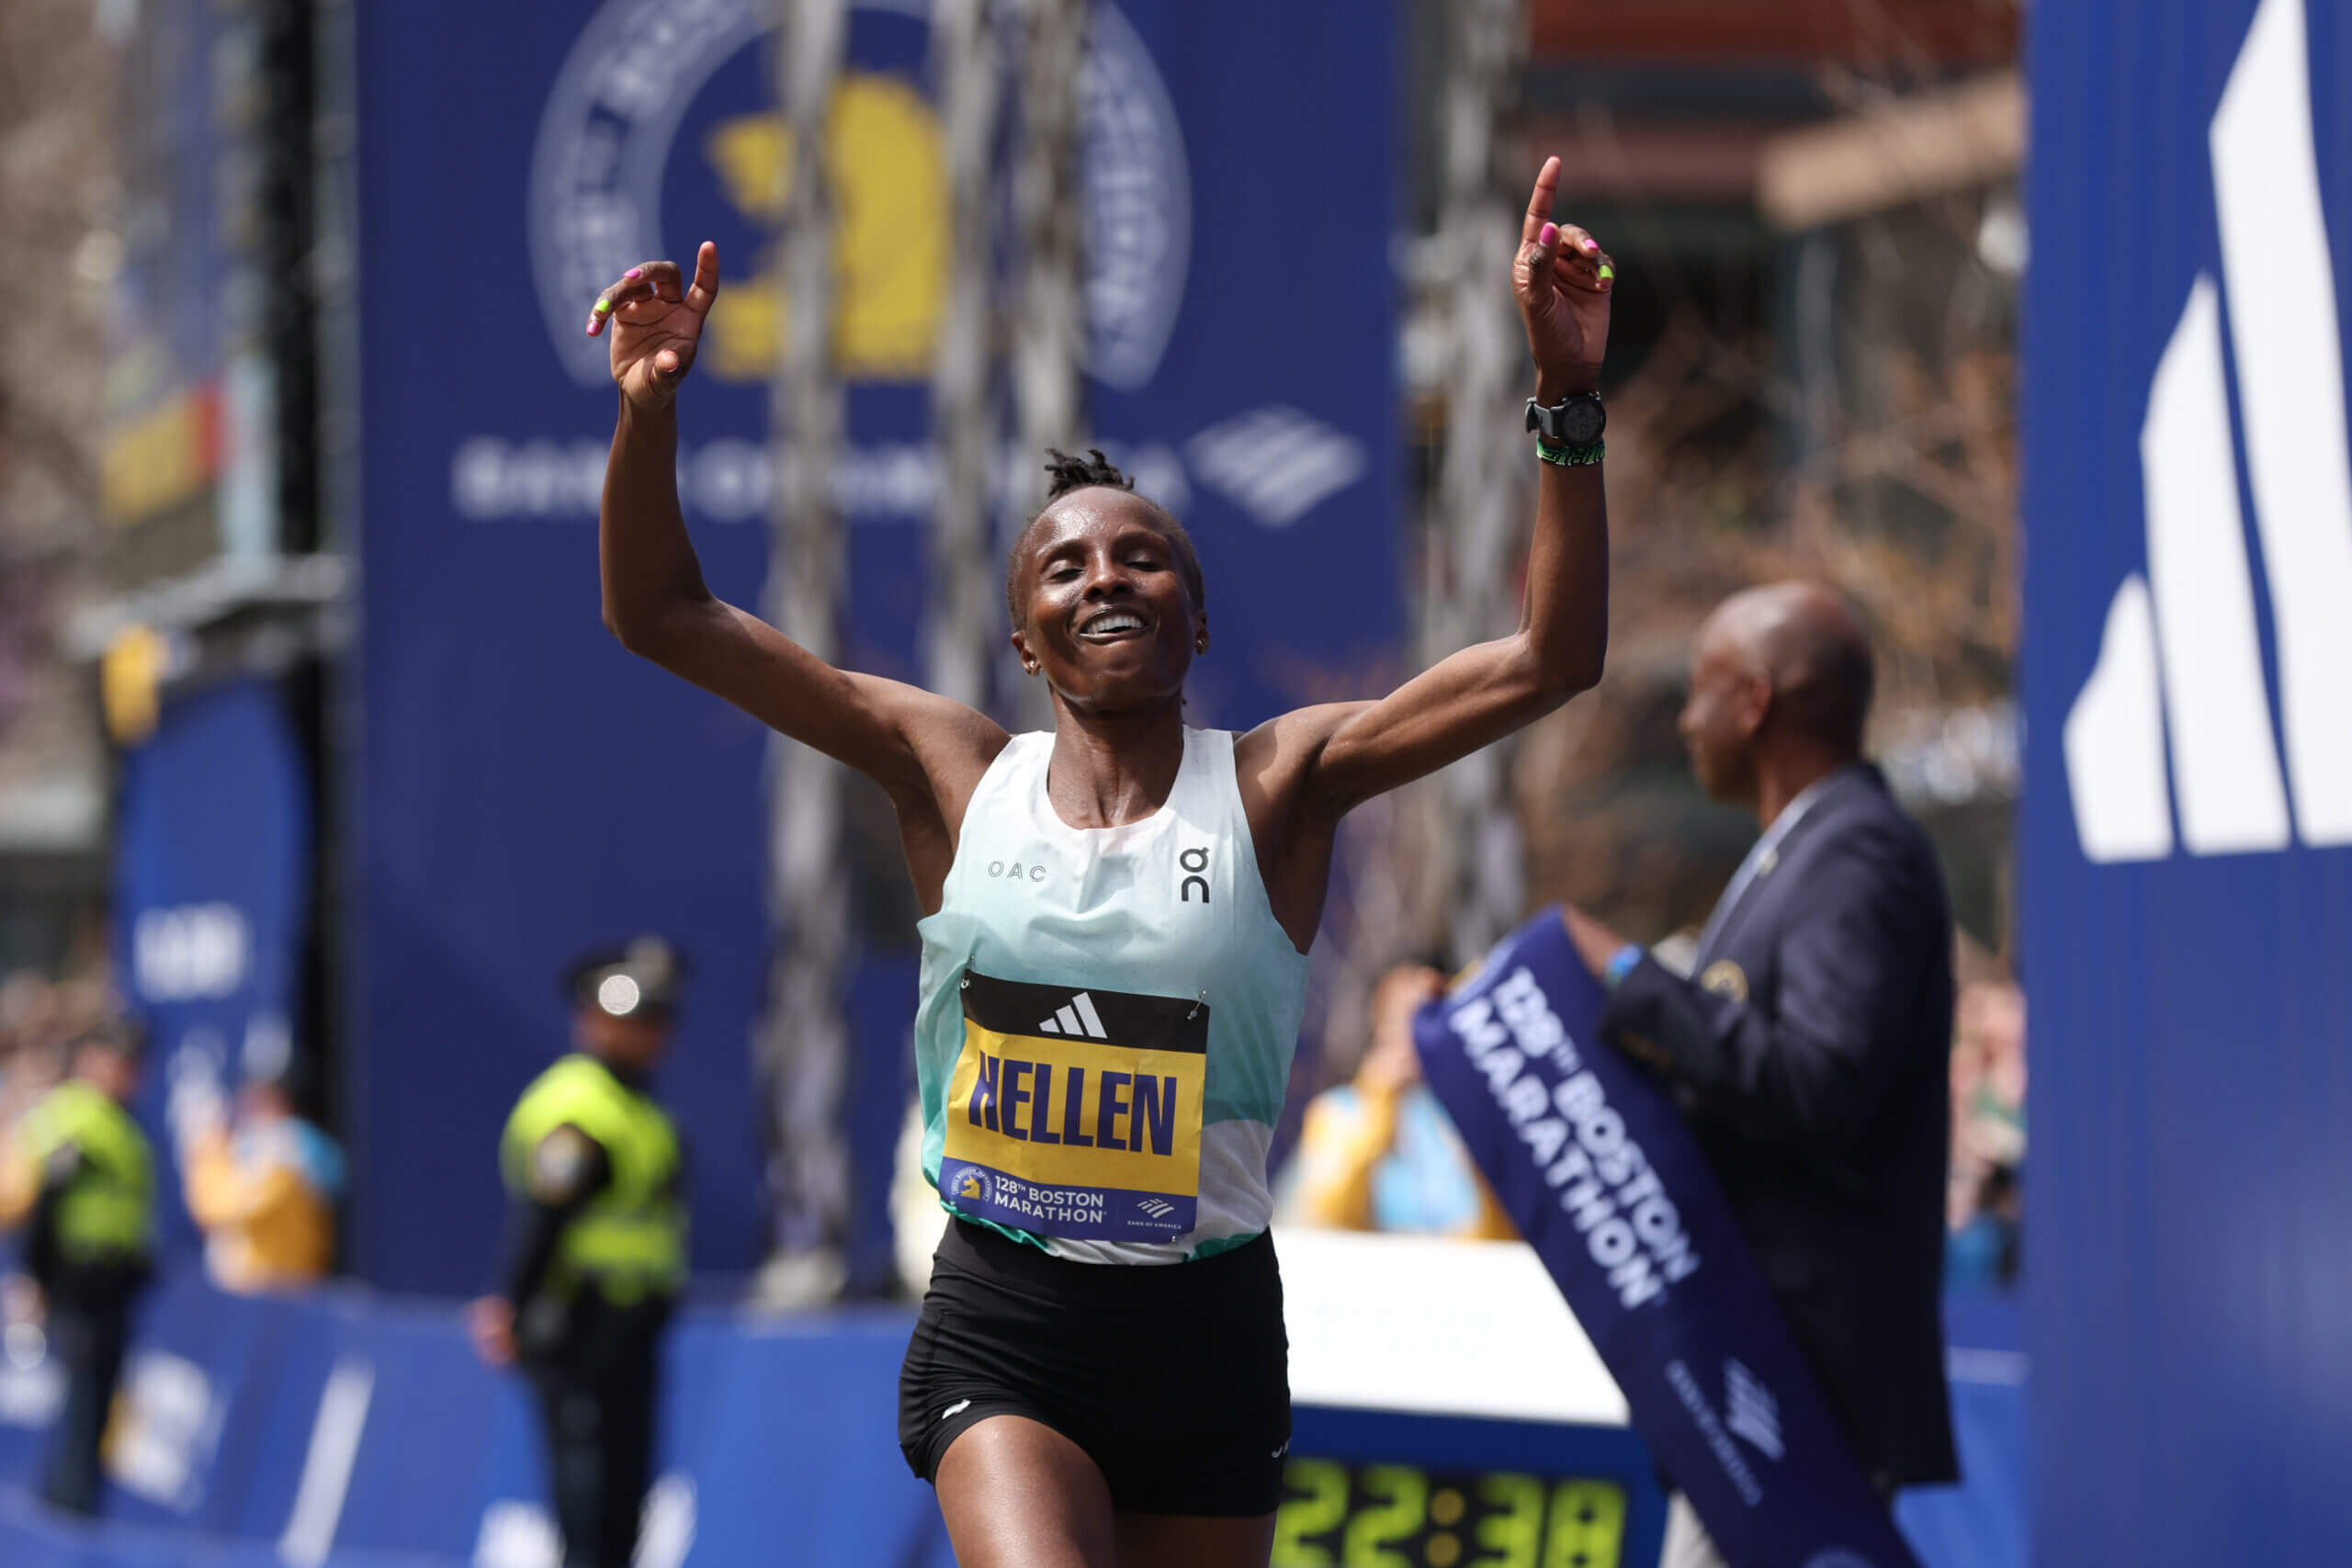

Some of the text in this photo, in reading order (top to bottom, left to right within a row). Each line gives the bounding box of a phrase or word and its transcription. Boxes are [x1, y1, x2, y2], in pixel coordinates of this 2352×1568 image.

[988, 861, 1047, 883] OAC
[968, 1050, 1177, 1156] HELLEN
[1450, 998, 1663, 1310] MARATHON
[1554, 1069, 1701, 1282] BOSTON
[1029, 1188, 1104, 1207] BOSTON
[1154, 1222, 1182, 1230] AMERICA
